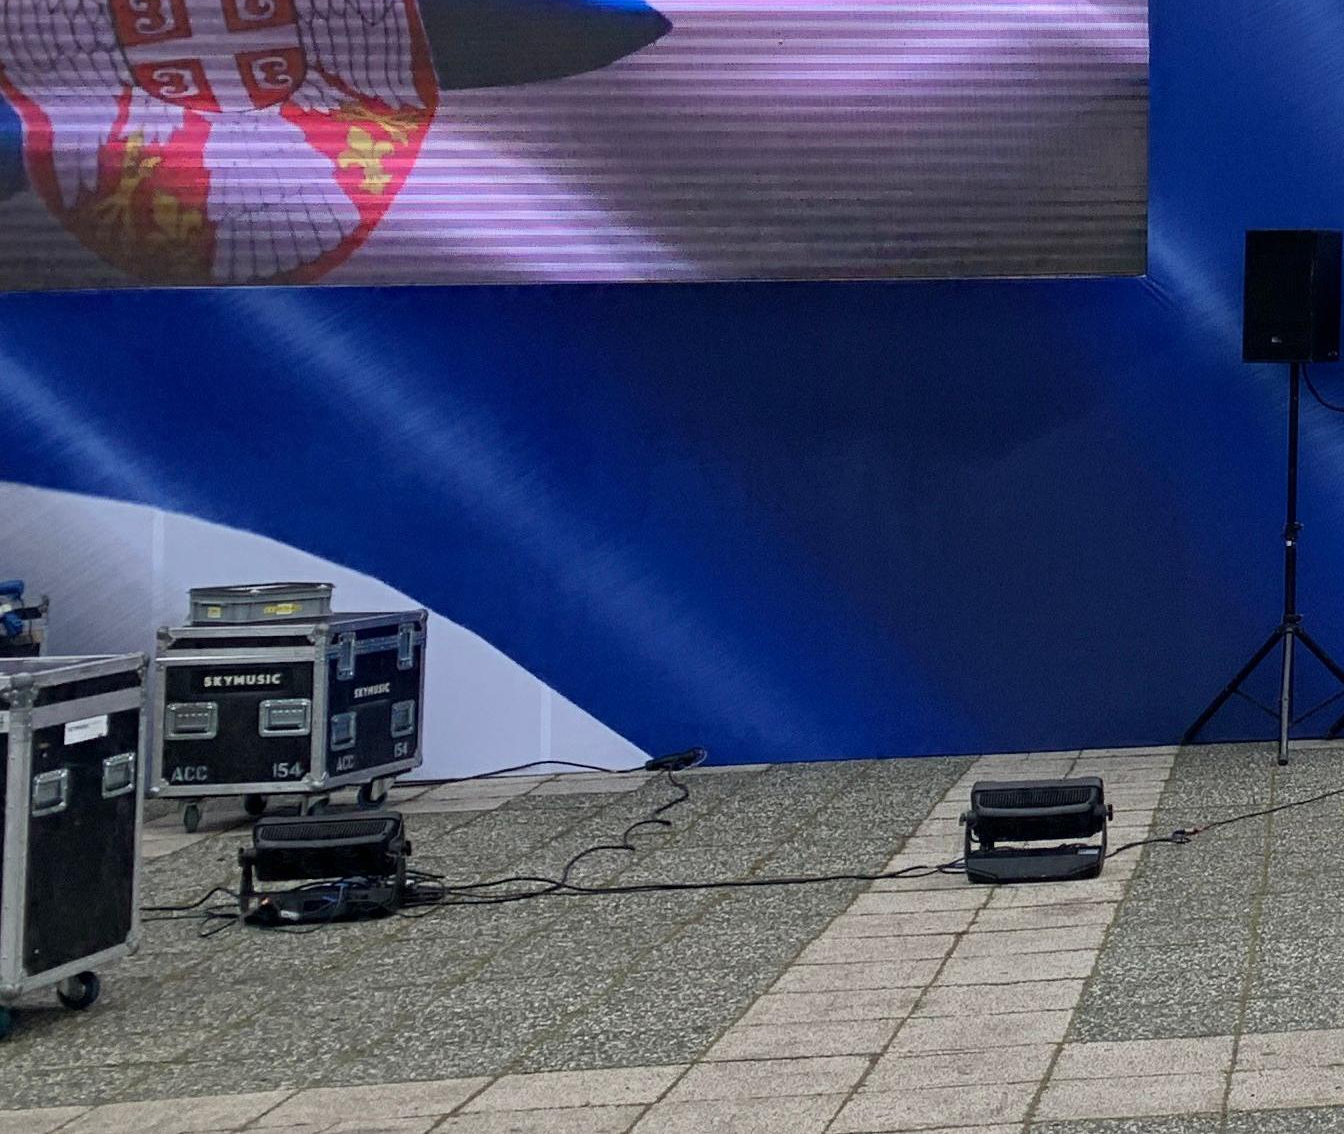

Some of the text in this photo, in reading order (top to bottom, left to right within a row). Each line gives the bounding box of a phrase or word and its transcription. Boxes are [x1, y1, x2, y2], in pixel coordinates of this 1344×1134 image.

[203, 673, 281, 688] SKYMUSIC
[353, 682, 391, 699] SKYMUSIC
[394, 742, 408, 758] 154
[171, 762, 301, 782] ACC 154
